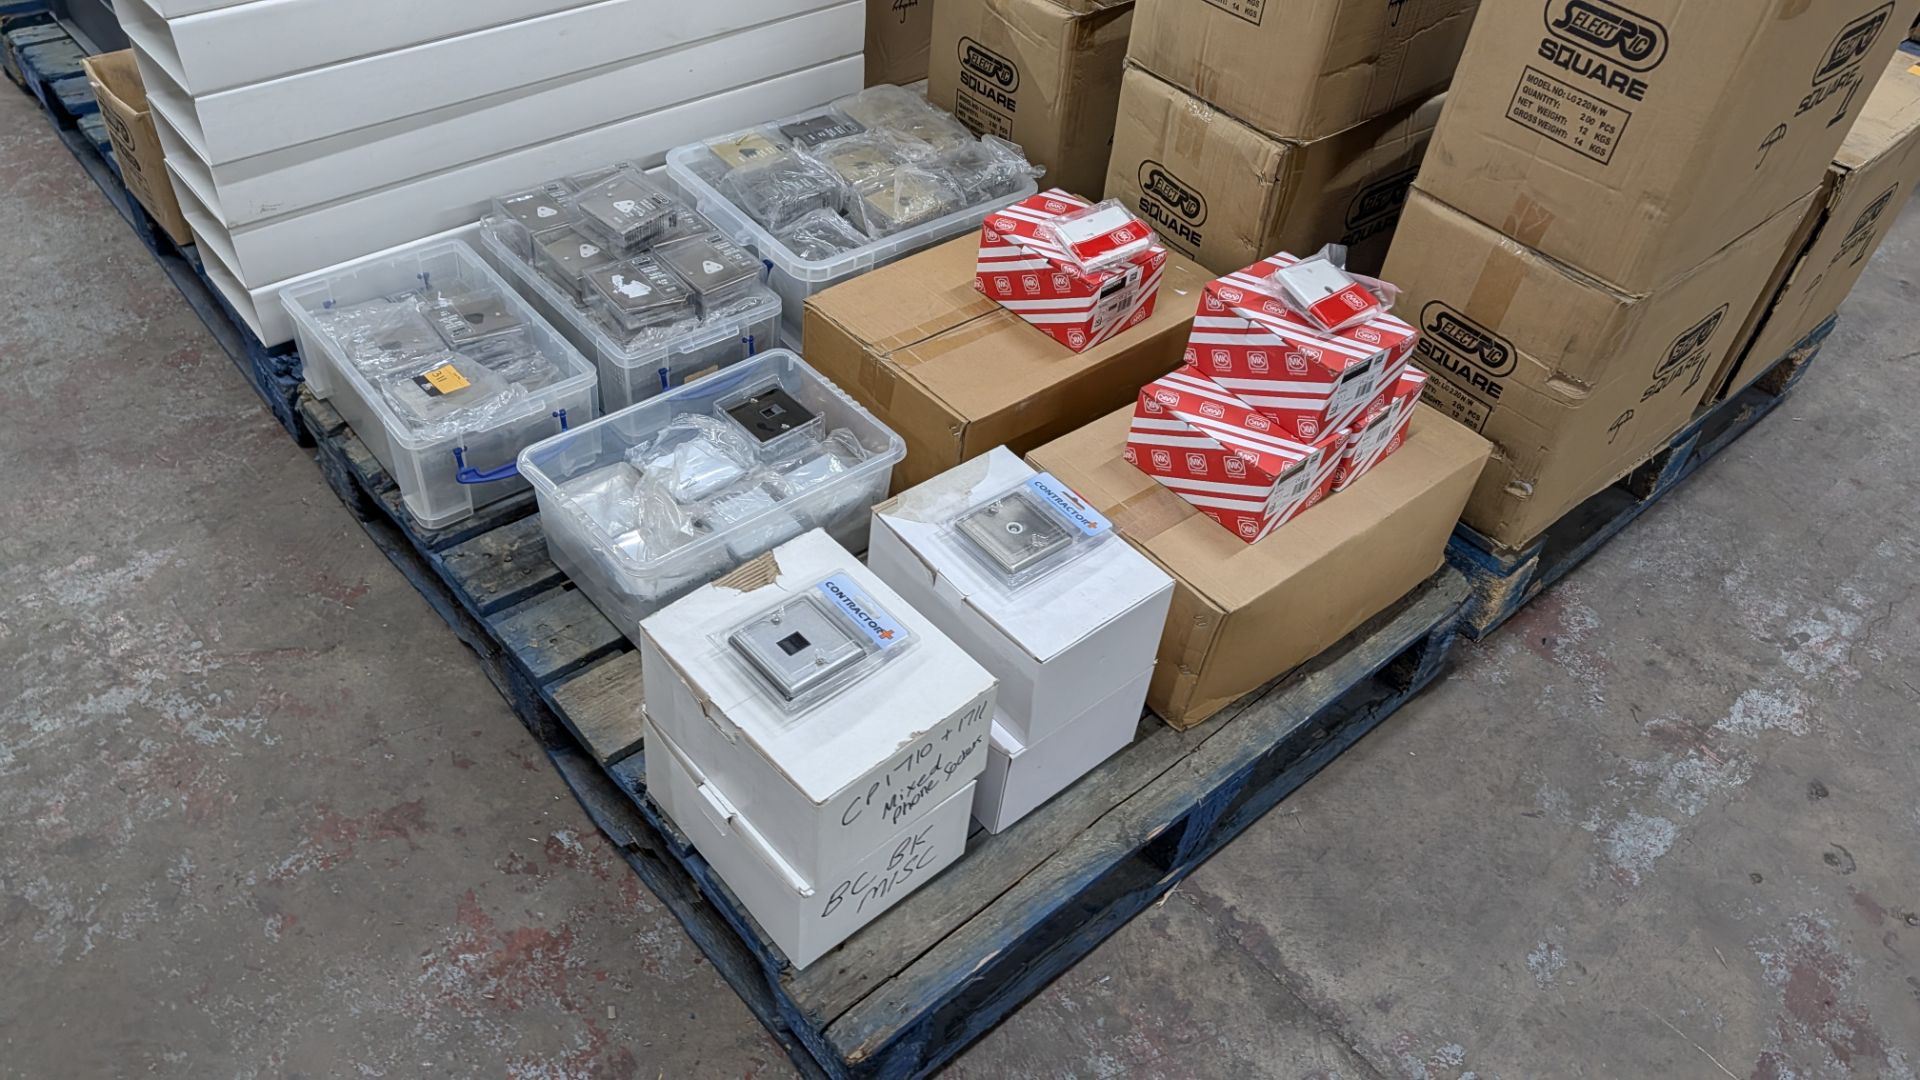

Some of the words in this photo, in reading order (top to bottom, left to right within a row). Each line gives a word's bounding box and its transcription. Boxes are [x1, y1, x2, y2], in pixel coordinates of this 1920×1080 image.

[1526, 74, 1552, 92] MODEL
[1538, 38, 1648, 101] SQUARE
[960, 70, 1016, 112] SQUARE
[1517, 96, 1533, 109] NET
[1522, 86, 1561, 109] QUANTITY:
[1139, 197, 1202, 247] SQUARE
[1417, 338, 1503, 399] SQUARE
